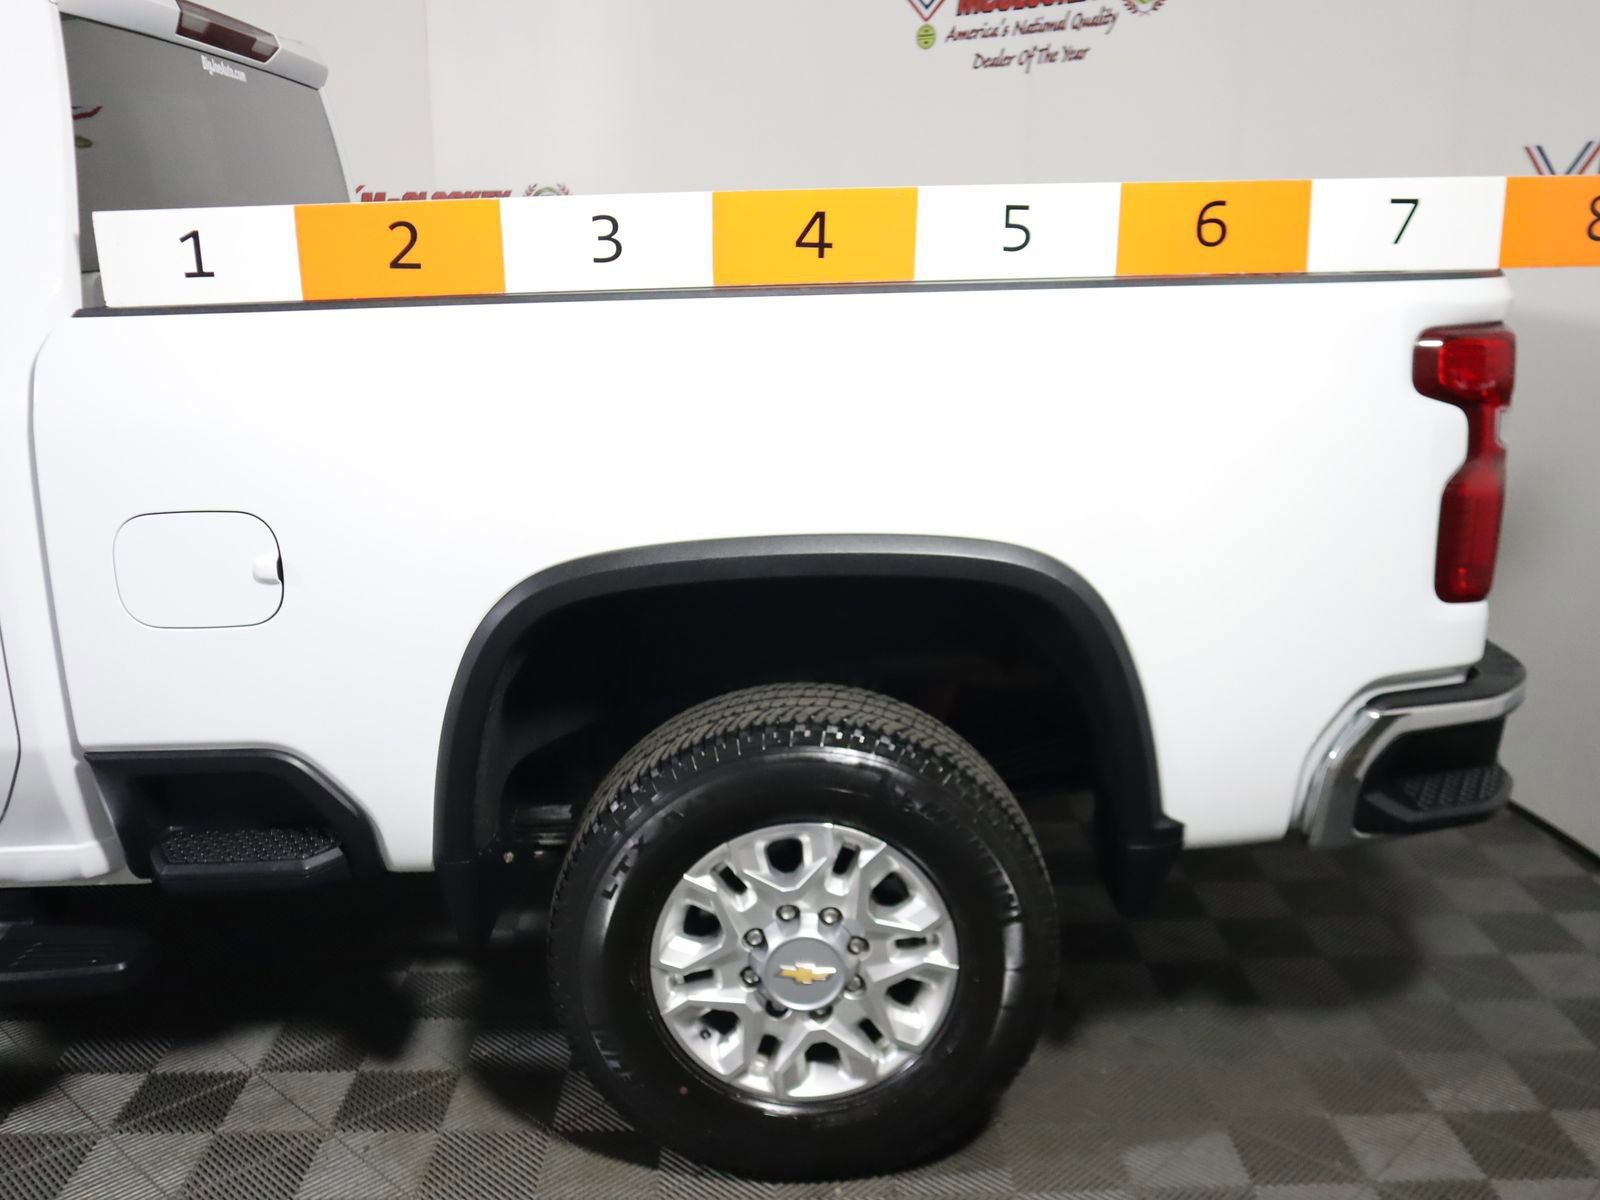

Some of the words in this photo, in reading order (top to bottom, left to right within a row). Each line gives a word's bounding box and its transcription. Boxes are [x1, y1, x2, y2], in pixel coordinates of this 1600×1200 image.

[945, 18, 1010, 43] America's
[1011, 10, 1072, 36] National
[1070, 5, 1120, 36] Quality
[972, 48, 1016, 70] Dealer
[1017, 45, 1038, 75] Of
[1036, 44, 1060, 65] The
[1061, 45, 1092, 64] Year
[180, 230, 215, 278] 1
[388, 220, 422, 270] 2
[592, 215, 623, 263] 3
[795, 211, 833, 259] 4
[1003, 205, 1030, 252] 5
[1196, 200, 1228, 248] 6
[1390, 198, 1420, 245] 7
